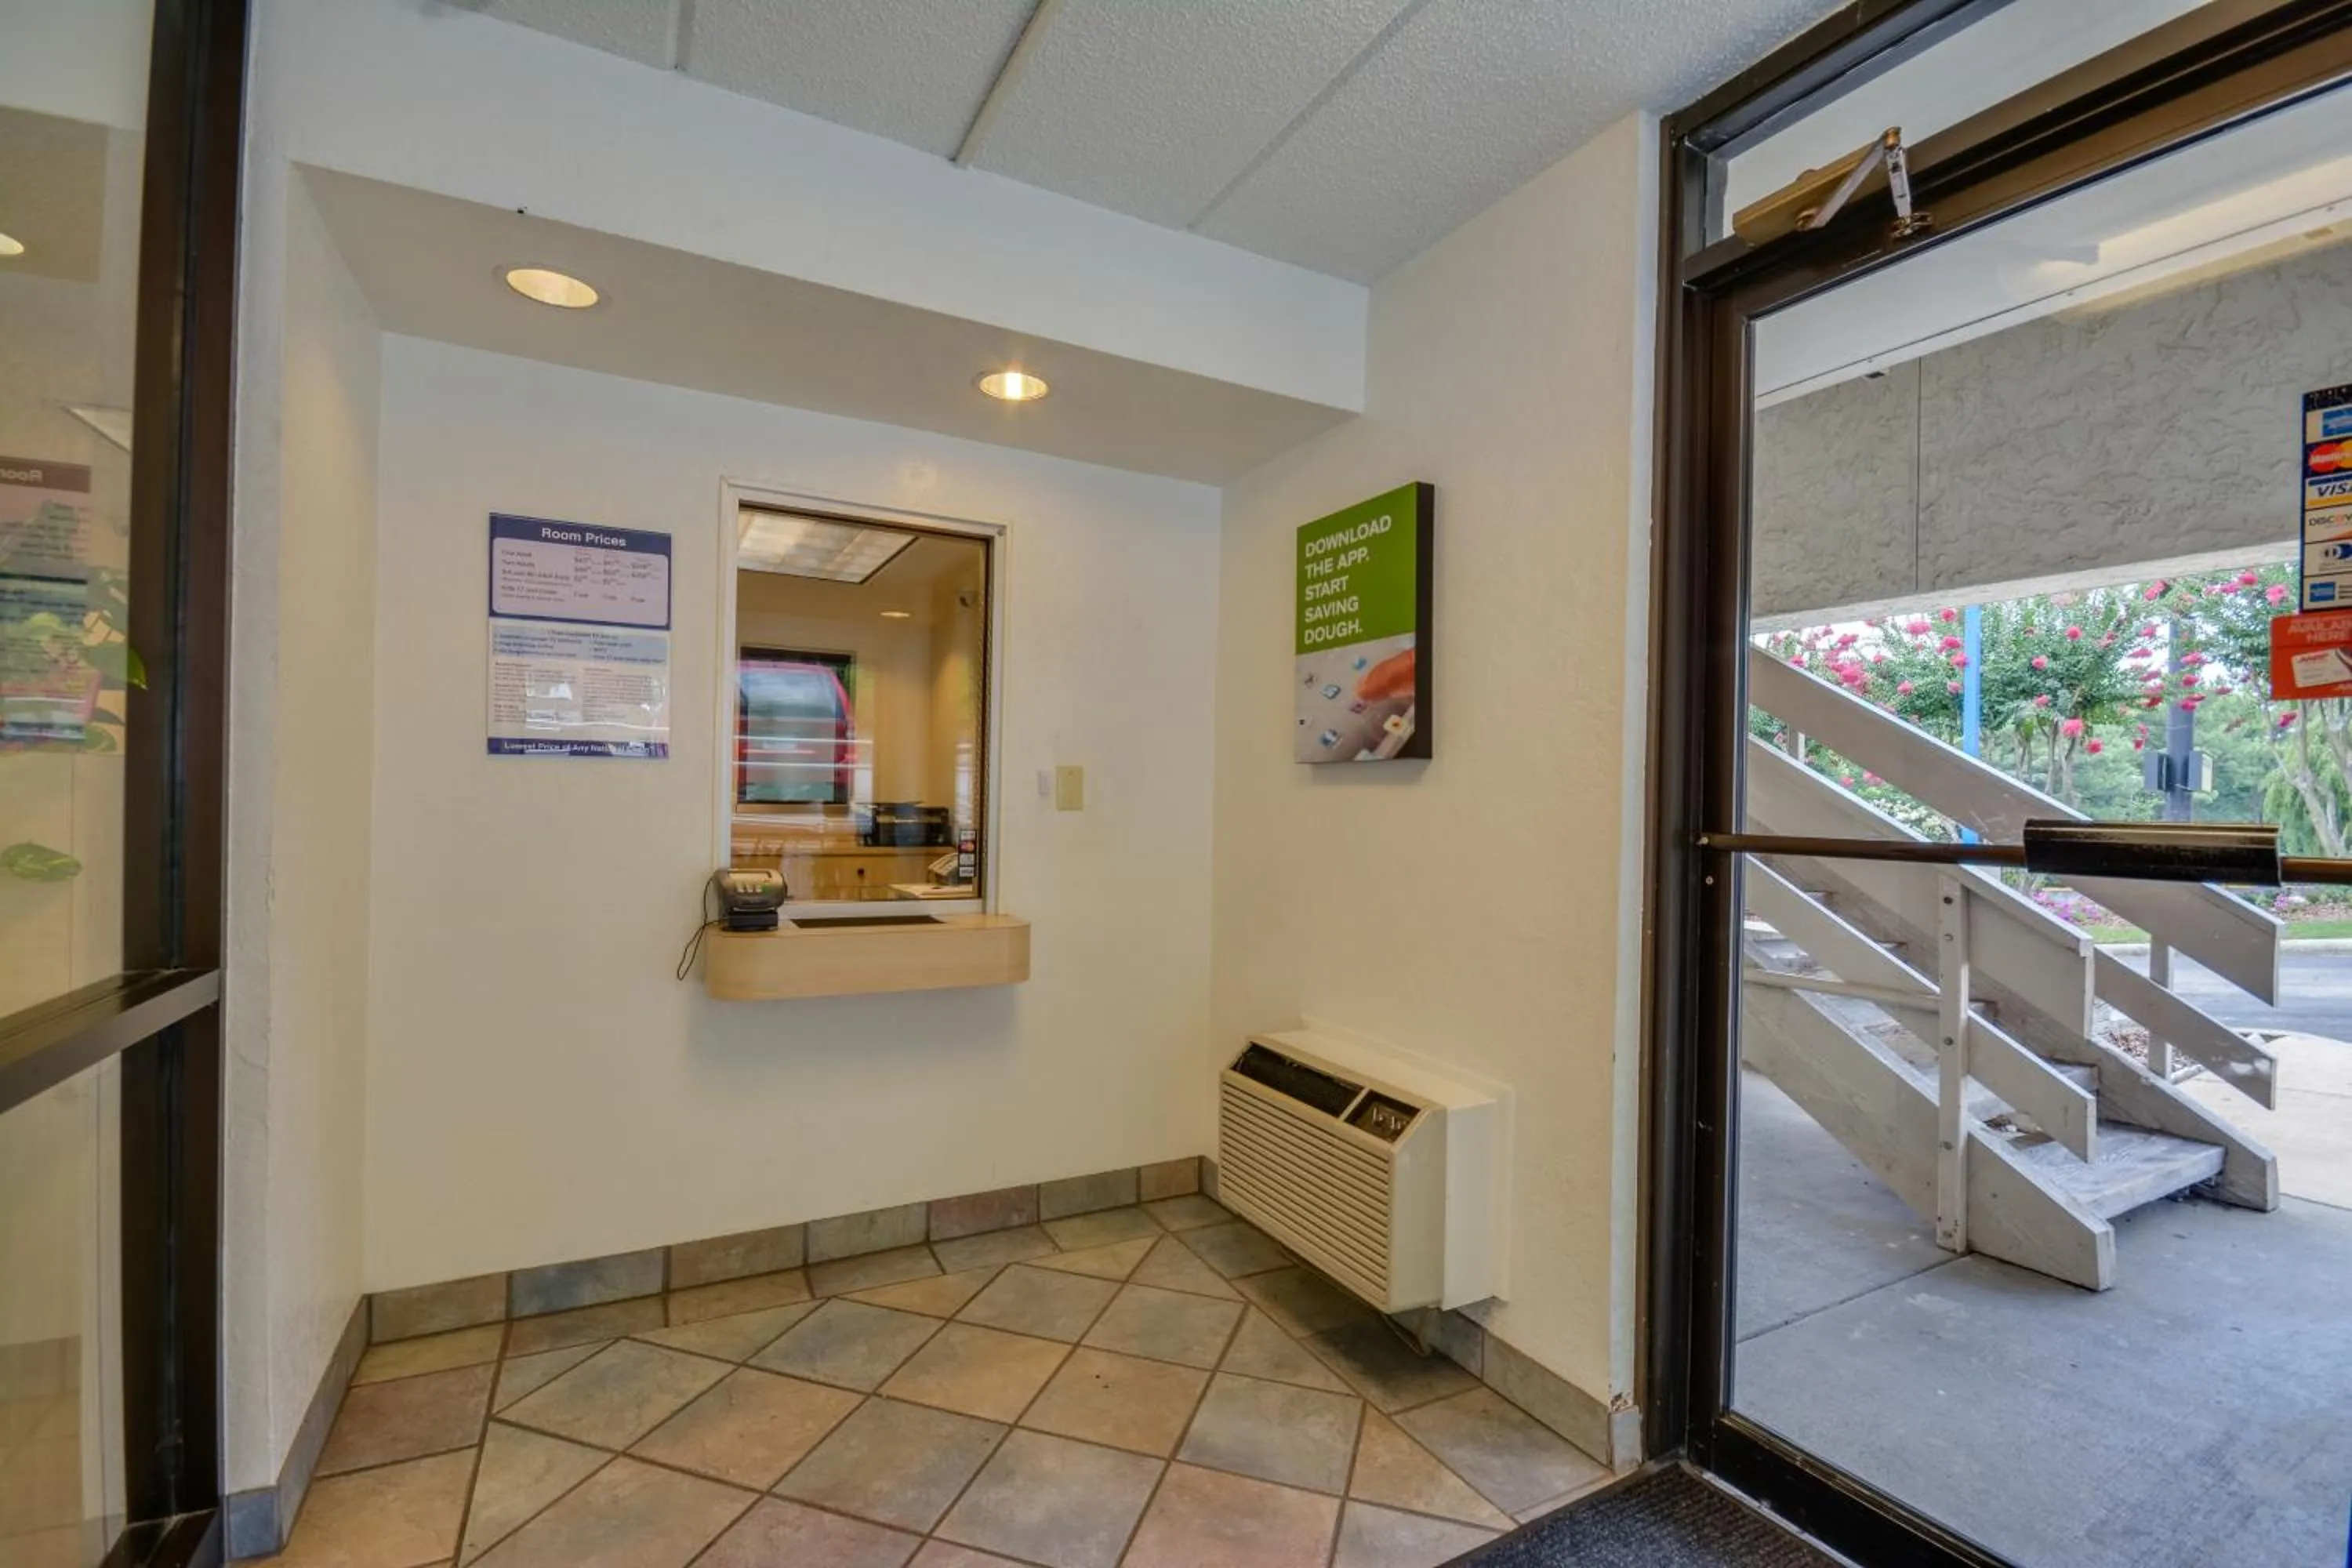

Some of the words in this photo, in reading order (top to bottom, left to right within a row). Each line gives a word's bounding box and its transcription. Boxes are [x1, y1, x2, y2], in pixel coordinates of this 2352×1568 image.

[542, 527, 581, 543] Room
[586, 532, 626, 546] Prices
[1305, 515, 1392, 557] DOWNLOAD
[1305, 557, 1333, 579] THE
[1337, 546, 1370, 570] APP.
[1305, 575, 1348, 601] START
[1305, 596, 1359, 623] SAVING
[1305, 619, 1363, 644] DOUGH.
